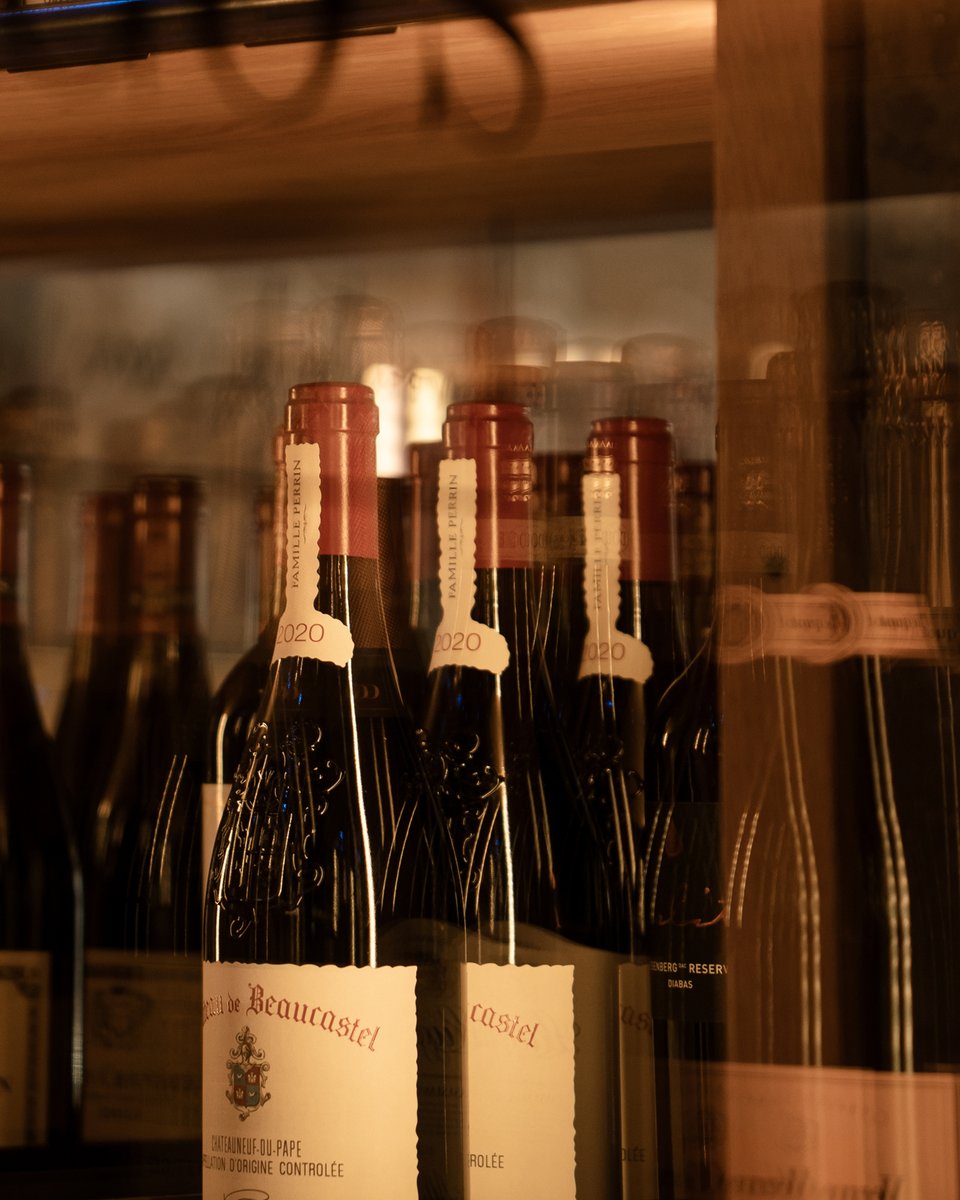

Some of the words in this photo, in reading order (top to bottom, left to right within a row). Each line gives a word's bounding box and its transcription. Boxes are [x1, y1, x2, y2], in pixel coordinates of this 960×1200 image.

[292, 459, 301, 514] PERRIN
[448, 474, 458, 527] PERRIN
[292, 520, 301, 589] FAMILLE
[448, 533, 457, 599] FAMILLE
[276, 622, 325, 645] 2020
[667, 978, 694, 990] DIABAS
[227, 992, 241, 1014] de
[246, 982, 381, 1052] Beaucastel
[211, 1134, 302, 1158] CHATEAUNEUF-DU-PAPE
[229, 1157, 274, 1176] D'ORIGINE
[279, 1160, 345, 1178] CONTROLÉE
